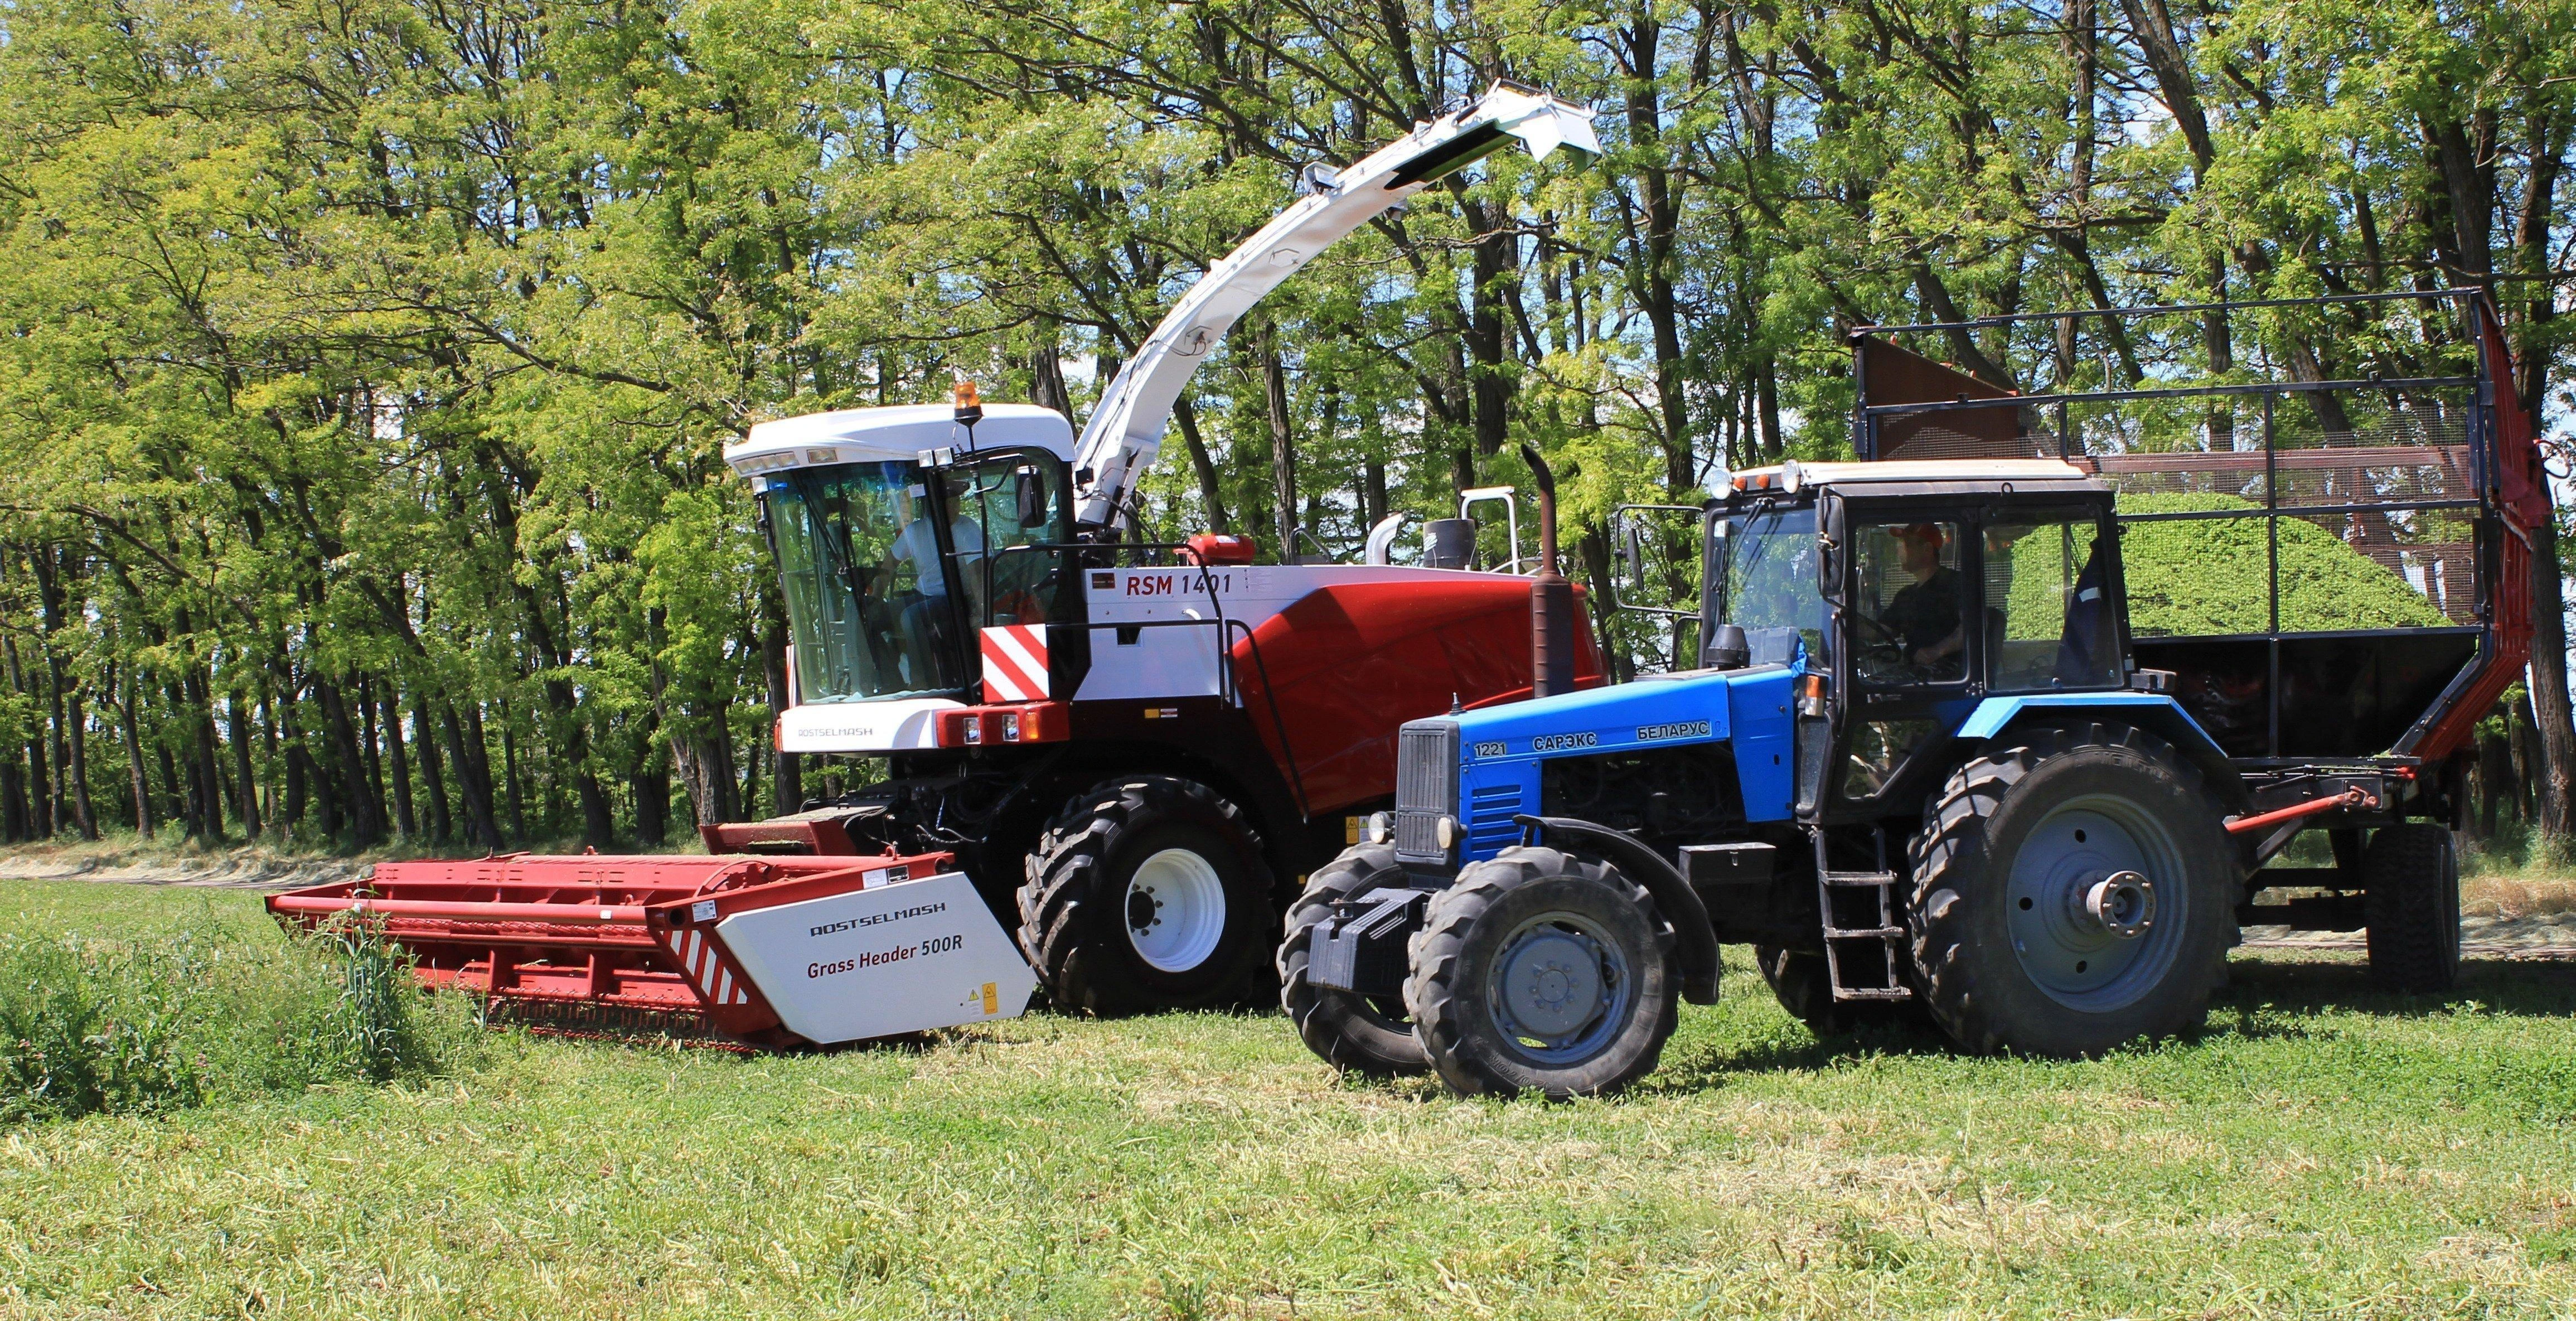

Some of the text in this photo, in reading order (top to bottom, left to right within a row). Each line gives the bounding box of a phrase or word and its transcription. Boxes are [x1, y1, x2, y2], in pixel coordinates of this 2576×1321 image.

[1126, 575, 1173, 596] RSM
[1182, 574, 1231, 594] 1401
[798, 727, 873, 737] ROSTSELMASH
[1474, 722, 1709, 756] 1221 САРЭКС БЕЛАРУС
[810, 902, 946, 936] ROSTSELMASH
[807, 935, 962, 979] Grass Header 500R
